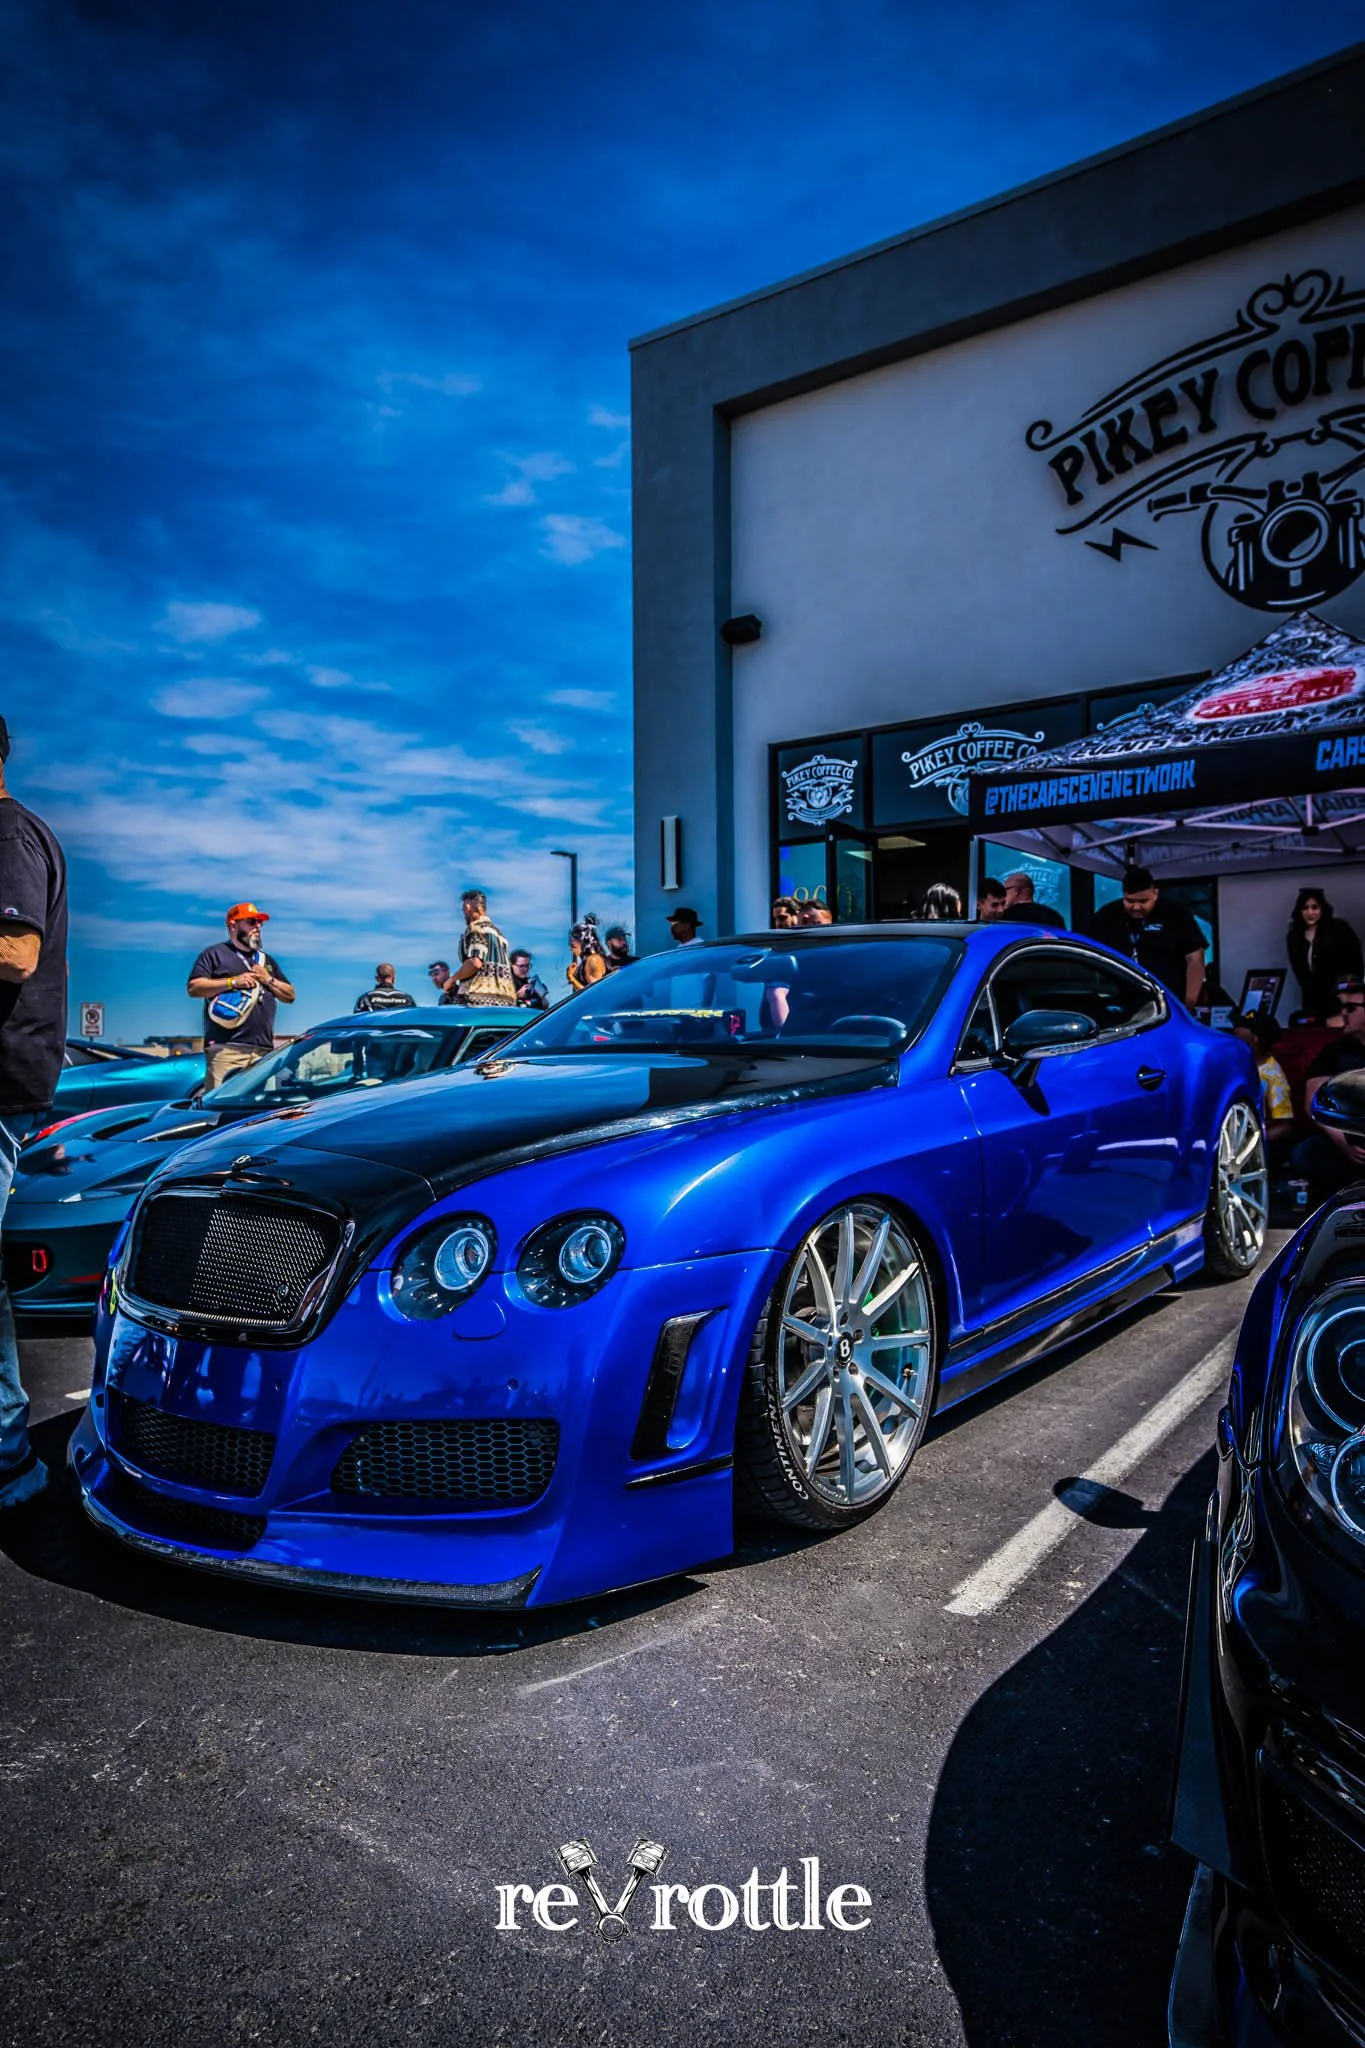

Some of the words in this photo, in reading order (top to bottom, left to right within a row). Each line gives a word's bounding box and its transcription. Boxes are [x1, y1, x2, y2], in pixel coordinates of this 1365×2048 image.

[1048, 367, 1219, 506] PIKEY
[909, 748, 955, 781] PIKEY
[958, 740, 1015, 762] COFFEE
[1072, 737, 1173, 759] EVENTS
[1203, 719, 1294, 743] MEDIA
[785, 768, 811, 789] PIKEY
[811, 765, 843, 778] COFFEE
[985, 759, 1197, 816] @THECARSCENENETWORK
[764, 1374, 809, 1500] CONTINENT
